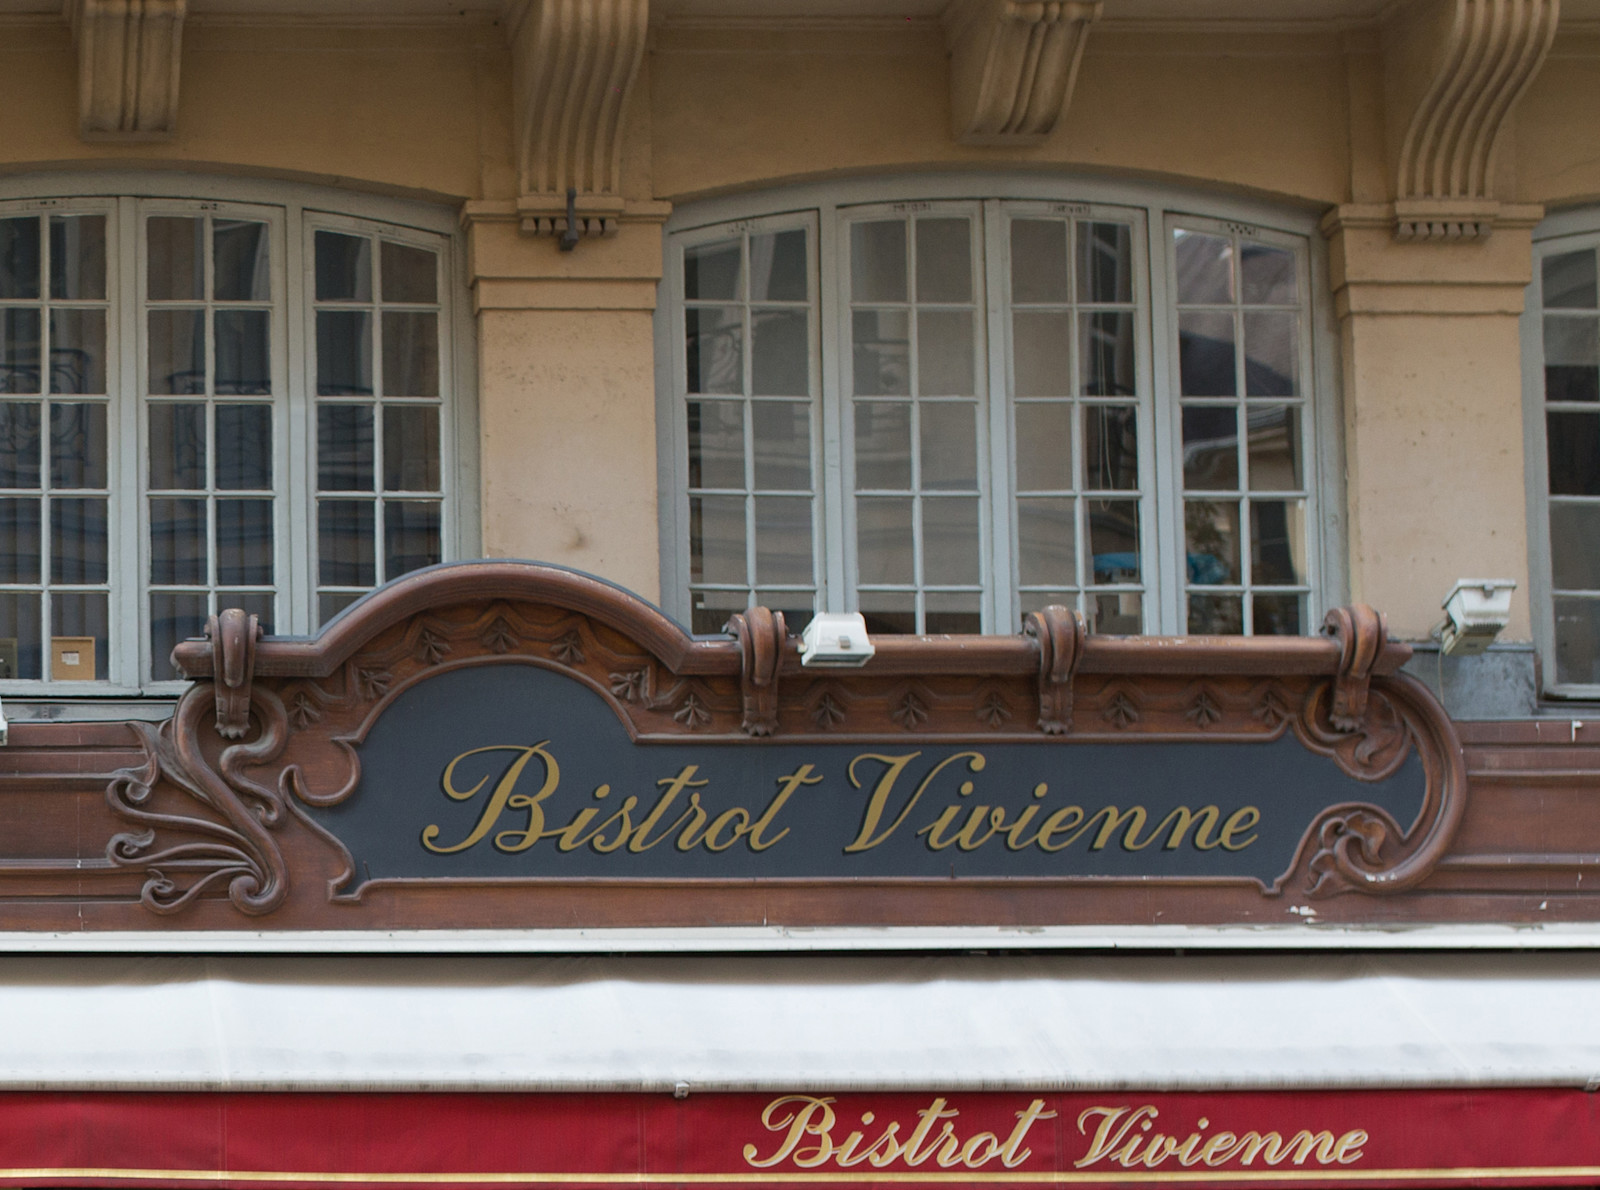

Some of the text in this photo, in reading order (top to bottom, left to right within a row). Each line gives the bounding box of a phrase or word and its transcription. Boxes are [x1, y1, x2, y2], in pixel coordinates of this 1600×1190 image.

[420, 739, 1261, 856] Bistrot Vivienne
[742, 1095, 1369, 1169] Bistrot Vivienne
